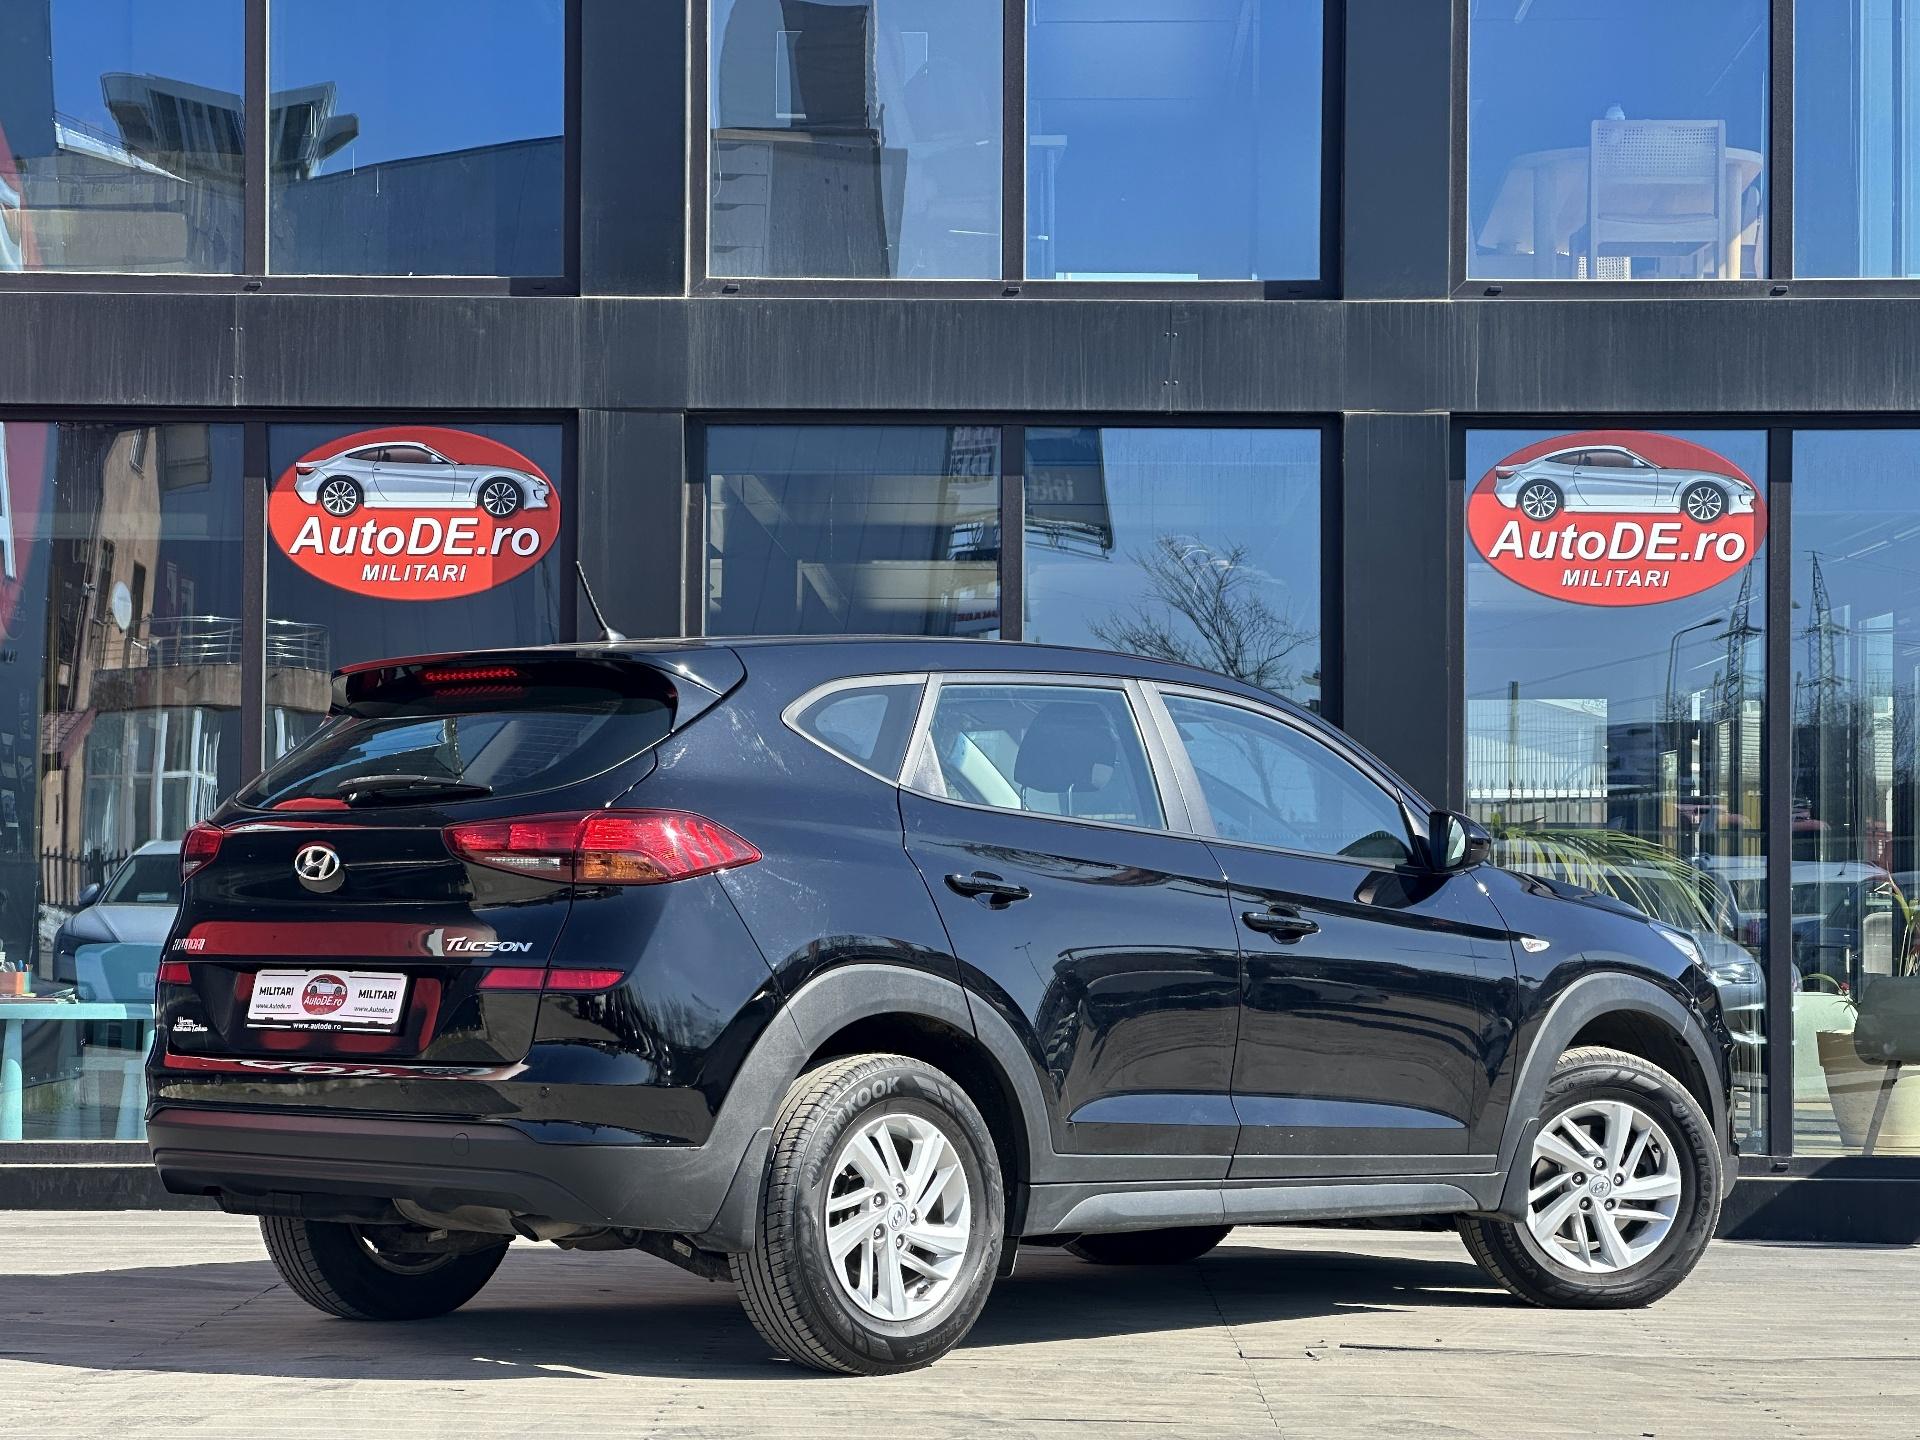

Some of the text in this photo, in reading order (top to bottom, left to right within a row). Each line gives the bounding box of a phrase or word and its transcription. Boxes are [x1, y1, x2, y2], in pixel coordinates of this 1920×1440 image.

[288, 516, 541, 556] AutoDE.ro
[1487, 520, 1747, 563] AutoDE.ro
[361, 564, 467, 583] MILITARI
[1561, 569, 1671, 588] MILITARI
[259, 986, 295, 996] MILITARI
[358, 989, 397, 1000] MILITARI
[304, 995, 343, 1006] AutoDE.ro
[293, 1022, 342, 1031] www.autode.ro
